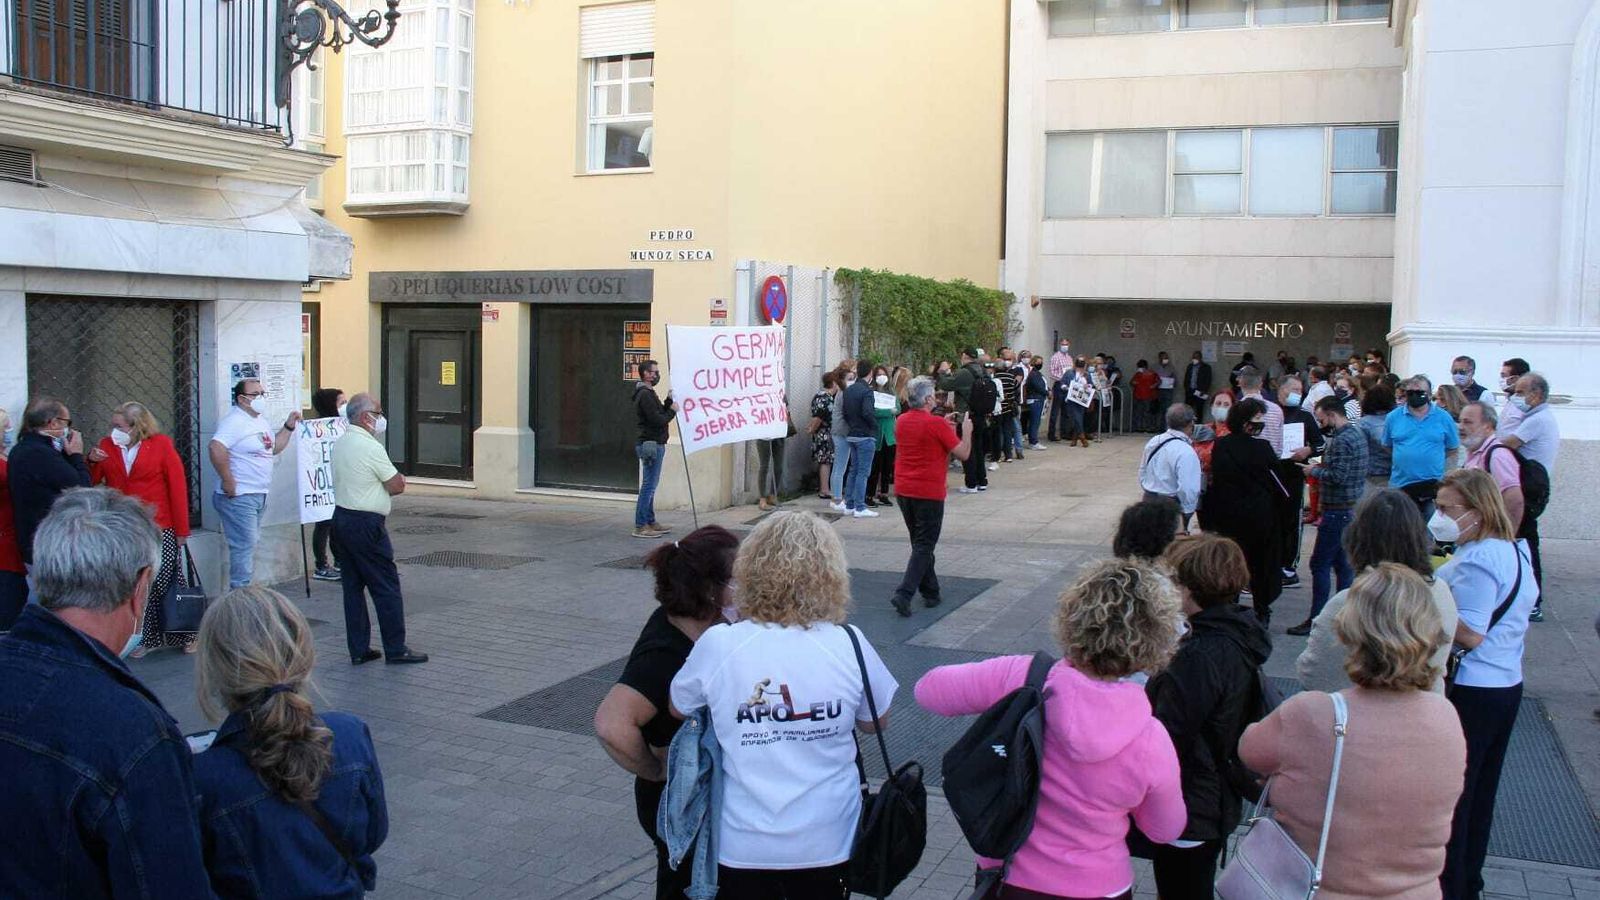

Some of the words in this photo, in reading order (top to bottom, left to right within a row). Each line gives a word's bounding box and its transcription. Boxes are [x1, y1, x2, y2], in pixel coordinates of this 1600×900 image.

[650, 230, 693, 240] PEDRO
[678, 250, 712, 260] SECA
[403, 277, 525, 298] PELUQUERIAS
[529, 277, 573, 295] LOW
[576, 276, 627, 296] COST
[1165, 321, 1304, 339] AYUNTAMIENTO
[693, 365, 773, 391] CUMPLE
[693, 411, 747, 441] SIERRA
[751, 407, 775, 425] SAN
[742, 731, 768, 739] APOYO
